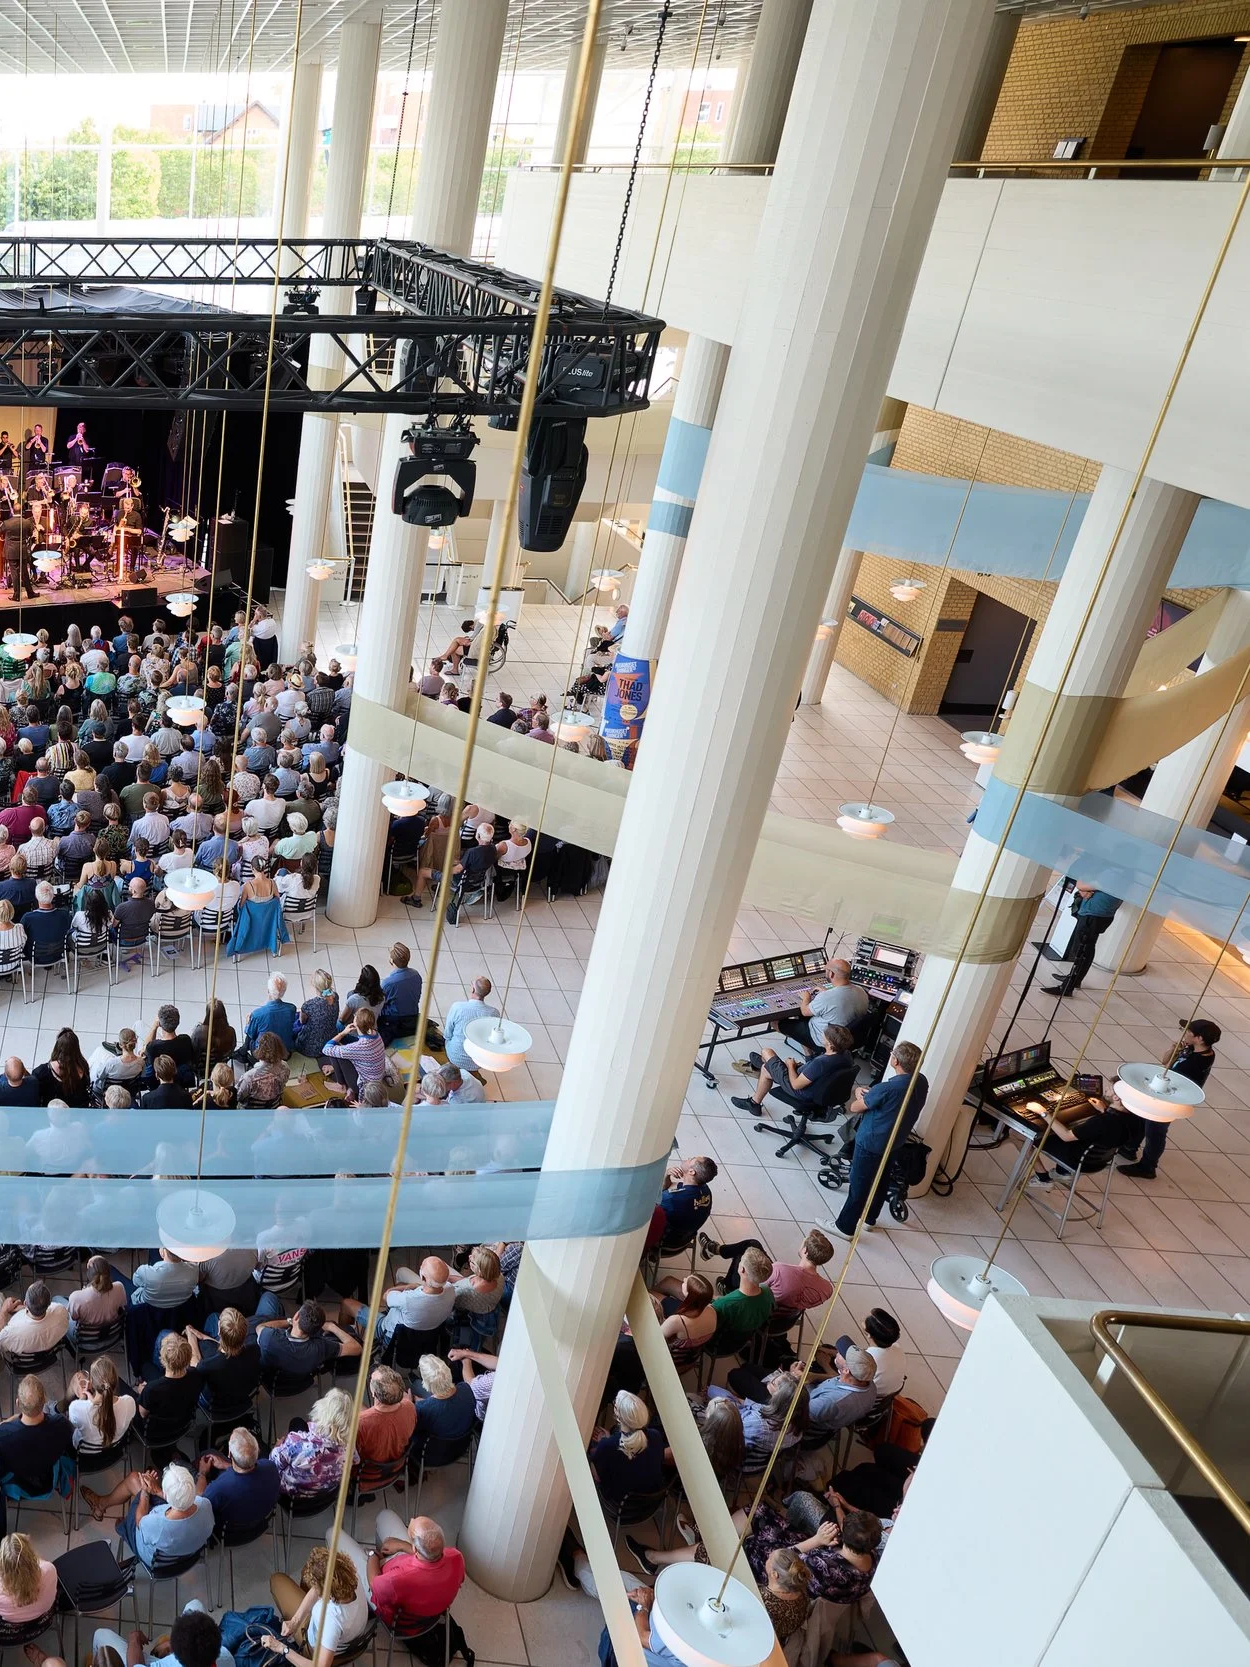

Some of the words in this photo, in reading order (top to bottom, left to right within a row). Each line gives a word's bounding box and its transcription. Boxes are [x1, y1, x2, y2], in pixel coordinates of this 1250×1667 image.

[619, 678, 643, 692] THAD
[614, 688, 643, 701] JONES
[277, 1248, 307, 1262] VANS
